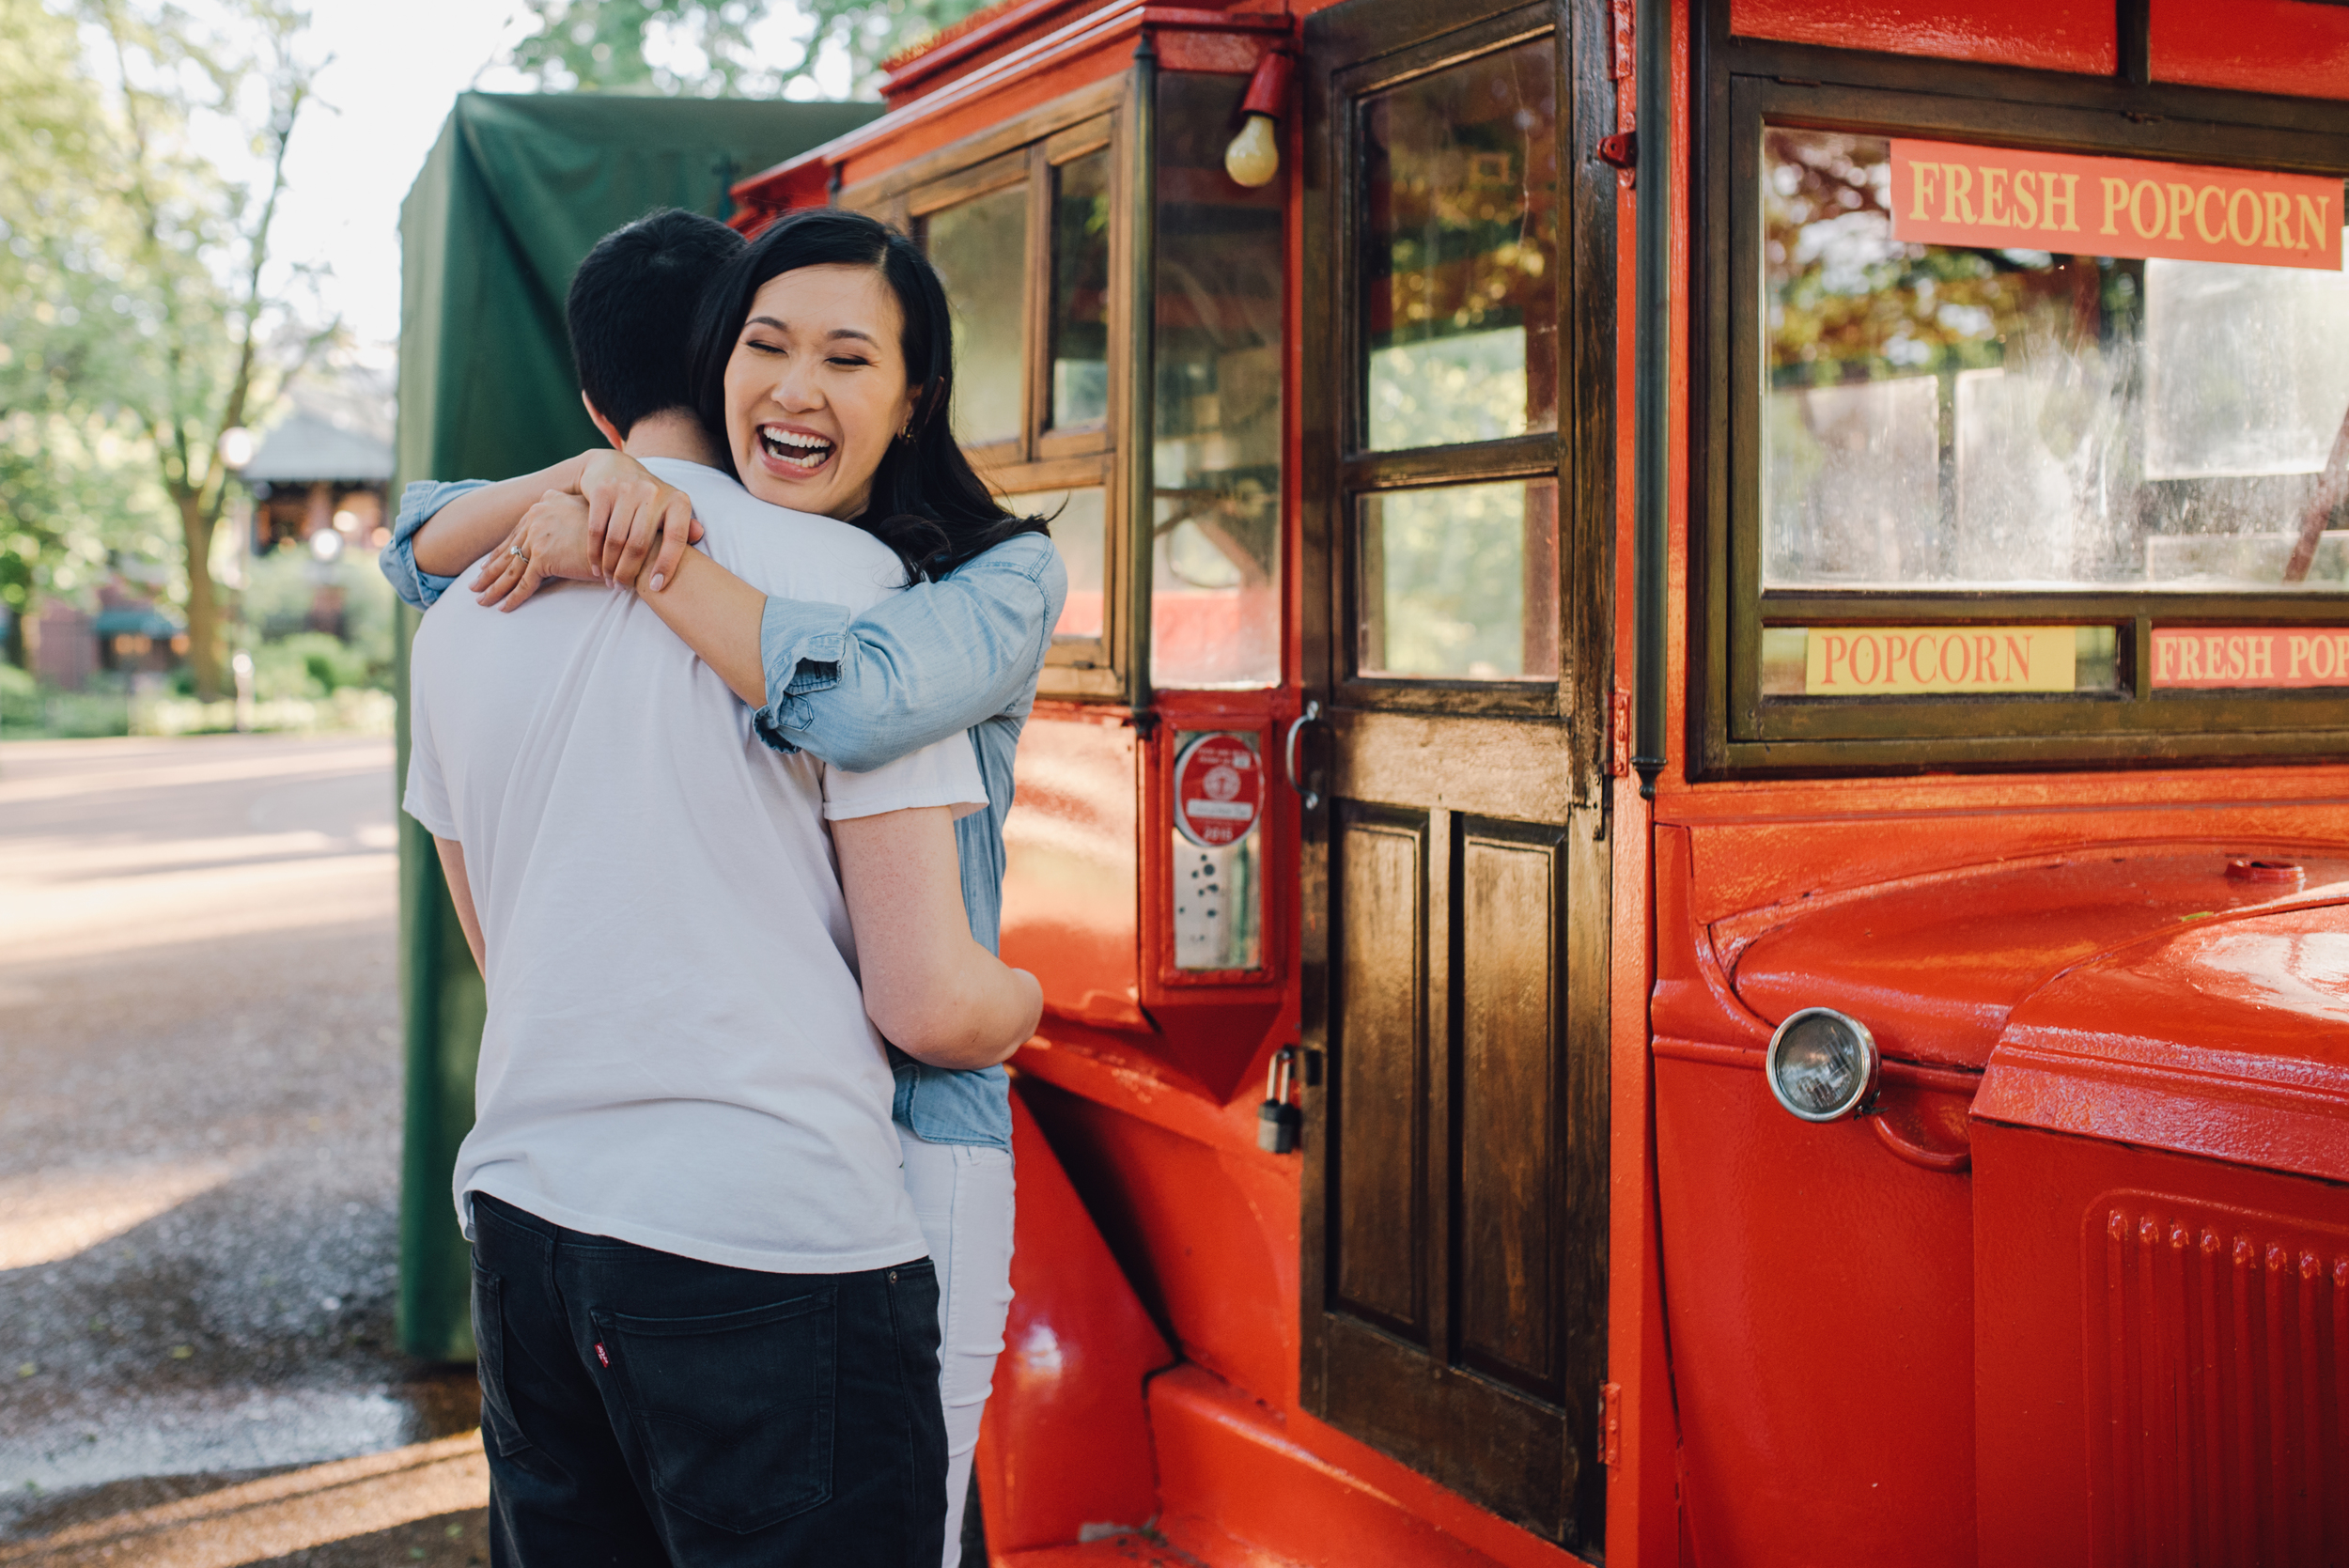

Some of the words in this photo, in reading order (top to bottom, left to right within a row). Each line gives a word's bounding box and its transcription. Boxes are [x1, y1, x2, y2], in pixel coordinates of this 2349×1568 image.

[1907, 160, 2081, 233] FRESH
[2099, 176, 2331, 252] POPCORN
[1820, 633, 2034, 686] POPCORN
[2155, 635, 2275, 681] FRESH
